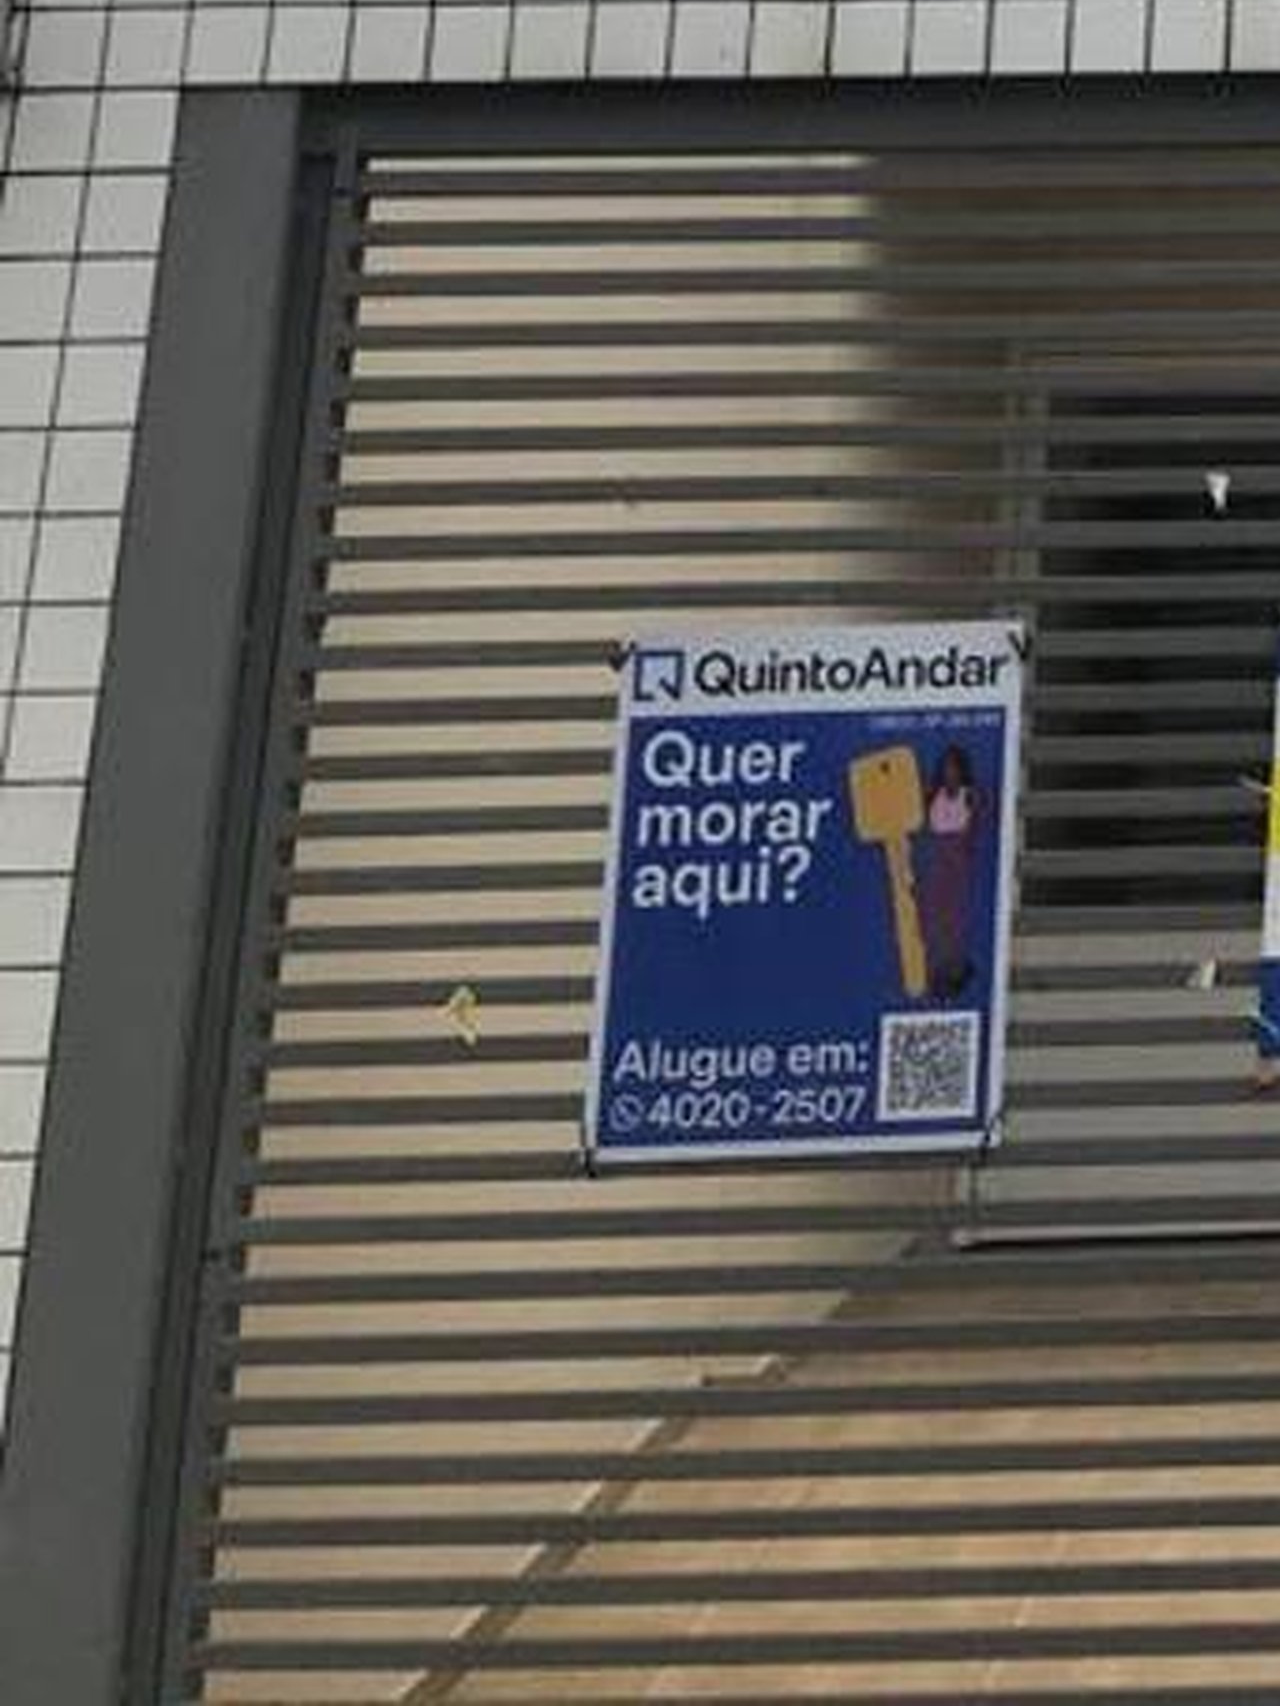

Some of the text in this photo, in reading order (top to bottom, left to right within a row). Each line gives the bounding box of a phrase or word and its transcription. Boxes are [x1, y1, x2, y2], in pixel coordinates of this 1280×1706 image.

[694, 647, 1009, 697] QuintoAndar
[642, 730, 806, 787] Quer
[637, 797, 832, 848] morar
[632, 844, 812, 918] aqui?
[613, 1039, 871, 1089] Alugue em:
[647, 1086, 867, 1130] 4020-2507
